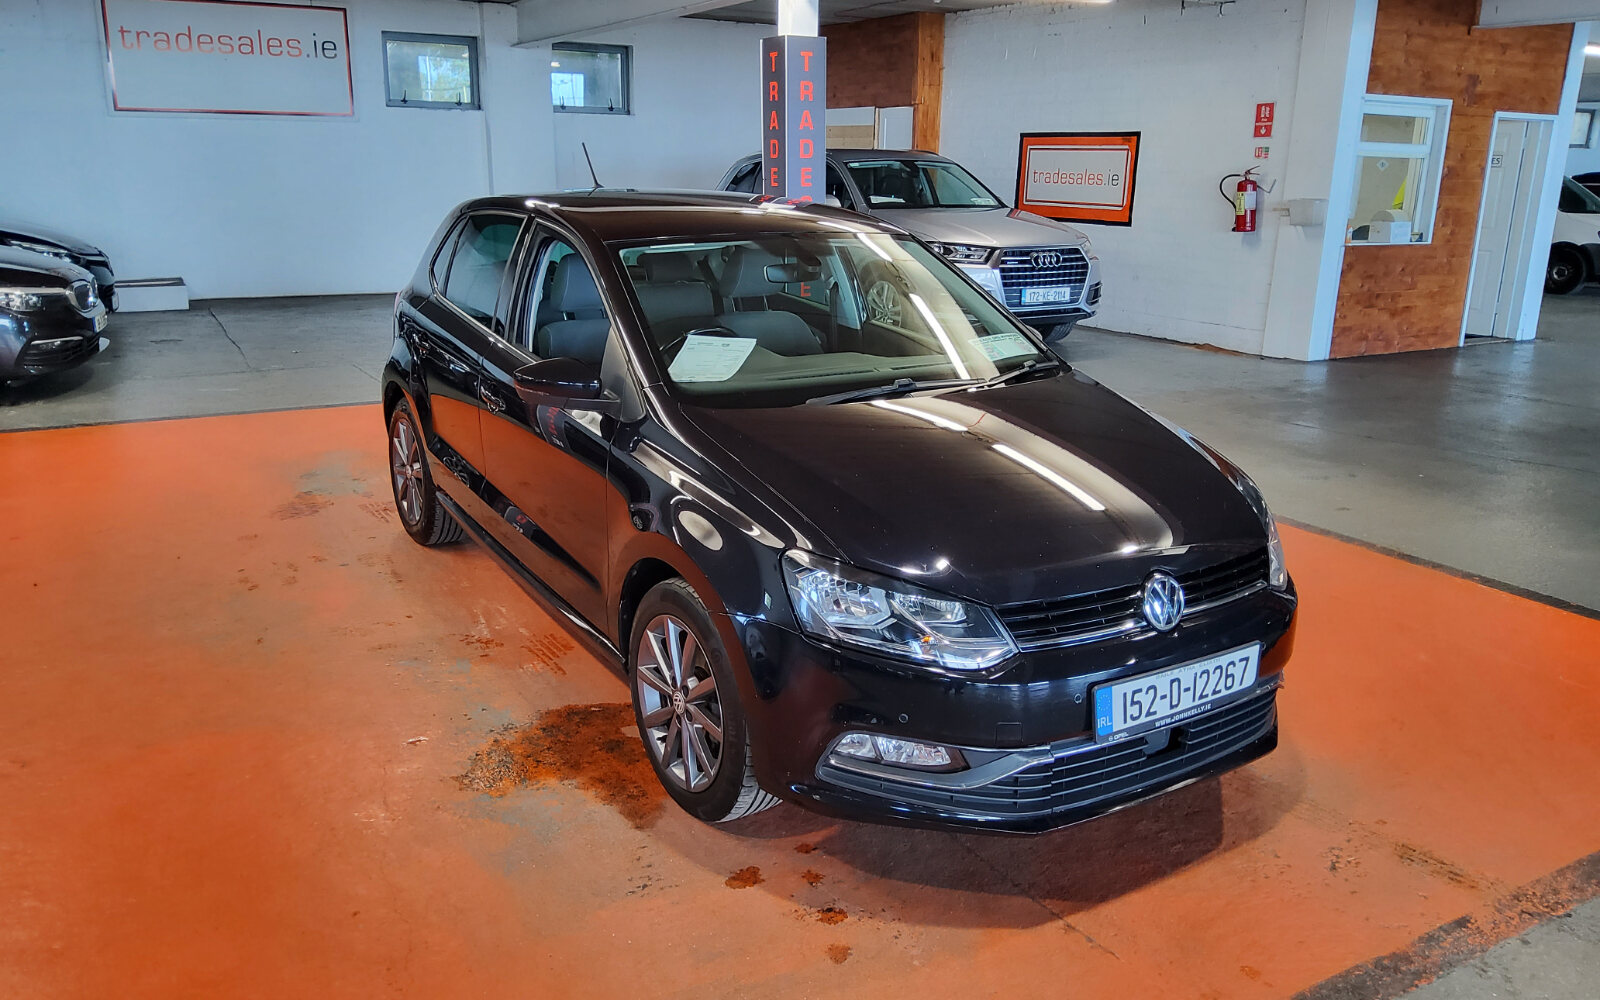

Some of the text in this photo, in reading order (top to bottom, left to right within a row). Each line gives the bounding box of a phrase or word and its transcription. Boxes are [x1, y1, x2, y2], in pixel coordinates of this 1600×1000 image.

[118, 25, 338, 59] tradesales.ie
[769, 51, 779, 187] TRADE
[1033, 168, 1119, 187] tradesales.ie
[1122, 655, 1250, 725] 152-D-12267
[1097, 716, 1113, 729] IRL
